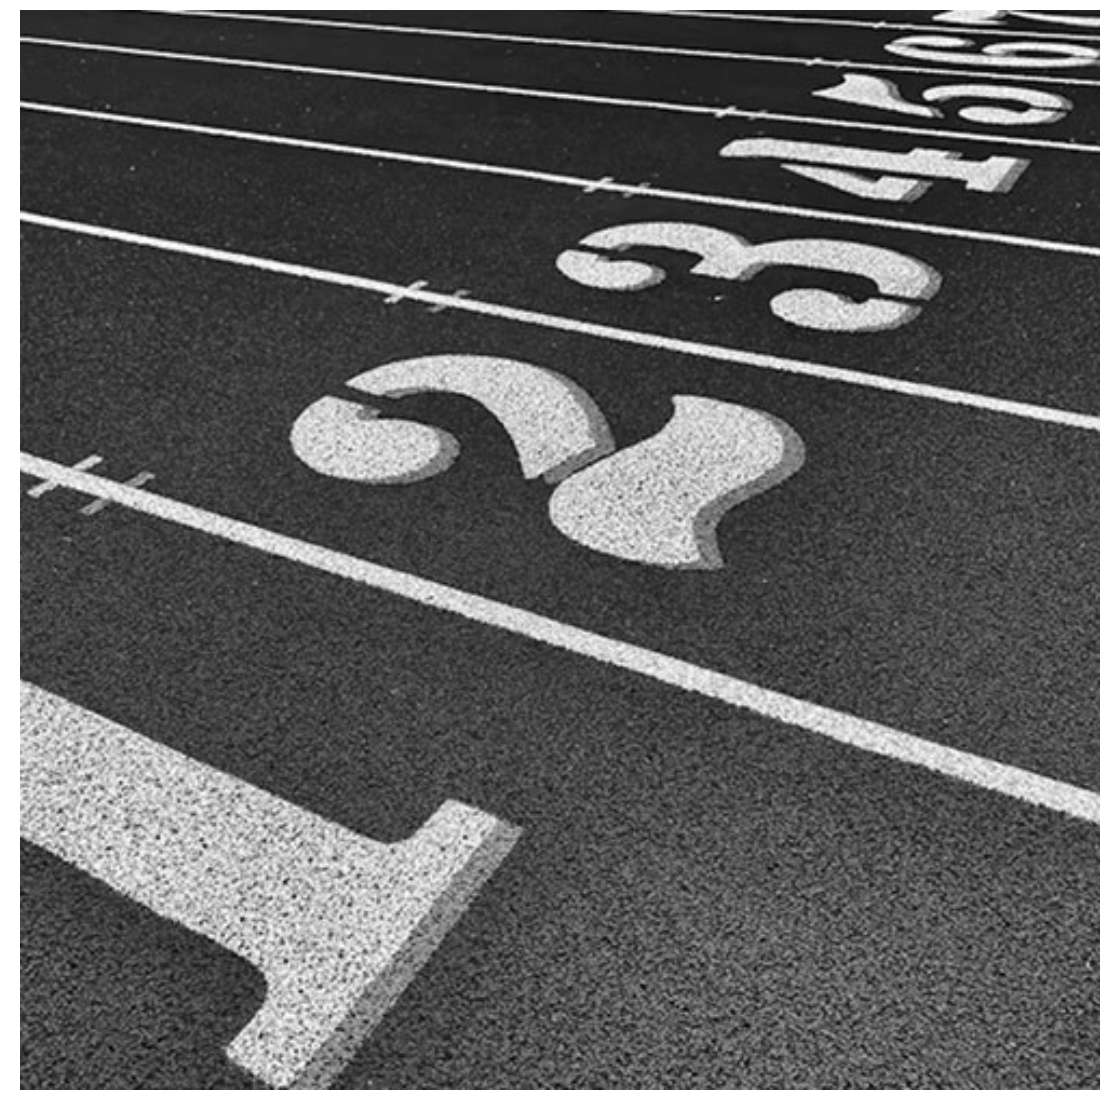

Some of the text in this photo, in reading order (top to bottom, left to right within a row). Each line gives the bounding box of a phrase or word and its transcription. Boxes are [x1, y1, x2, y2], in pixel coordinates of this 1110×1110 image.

[884, 36, 1099, 77] 6
[812, 74, 1073, 135] 5
[719, 138, 1031, 202] 4
[556, 221, 942, 332] 3
[290, 354, 805, 570] 2
